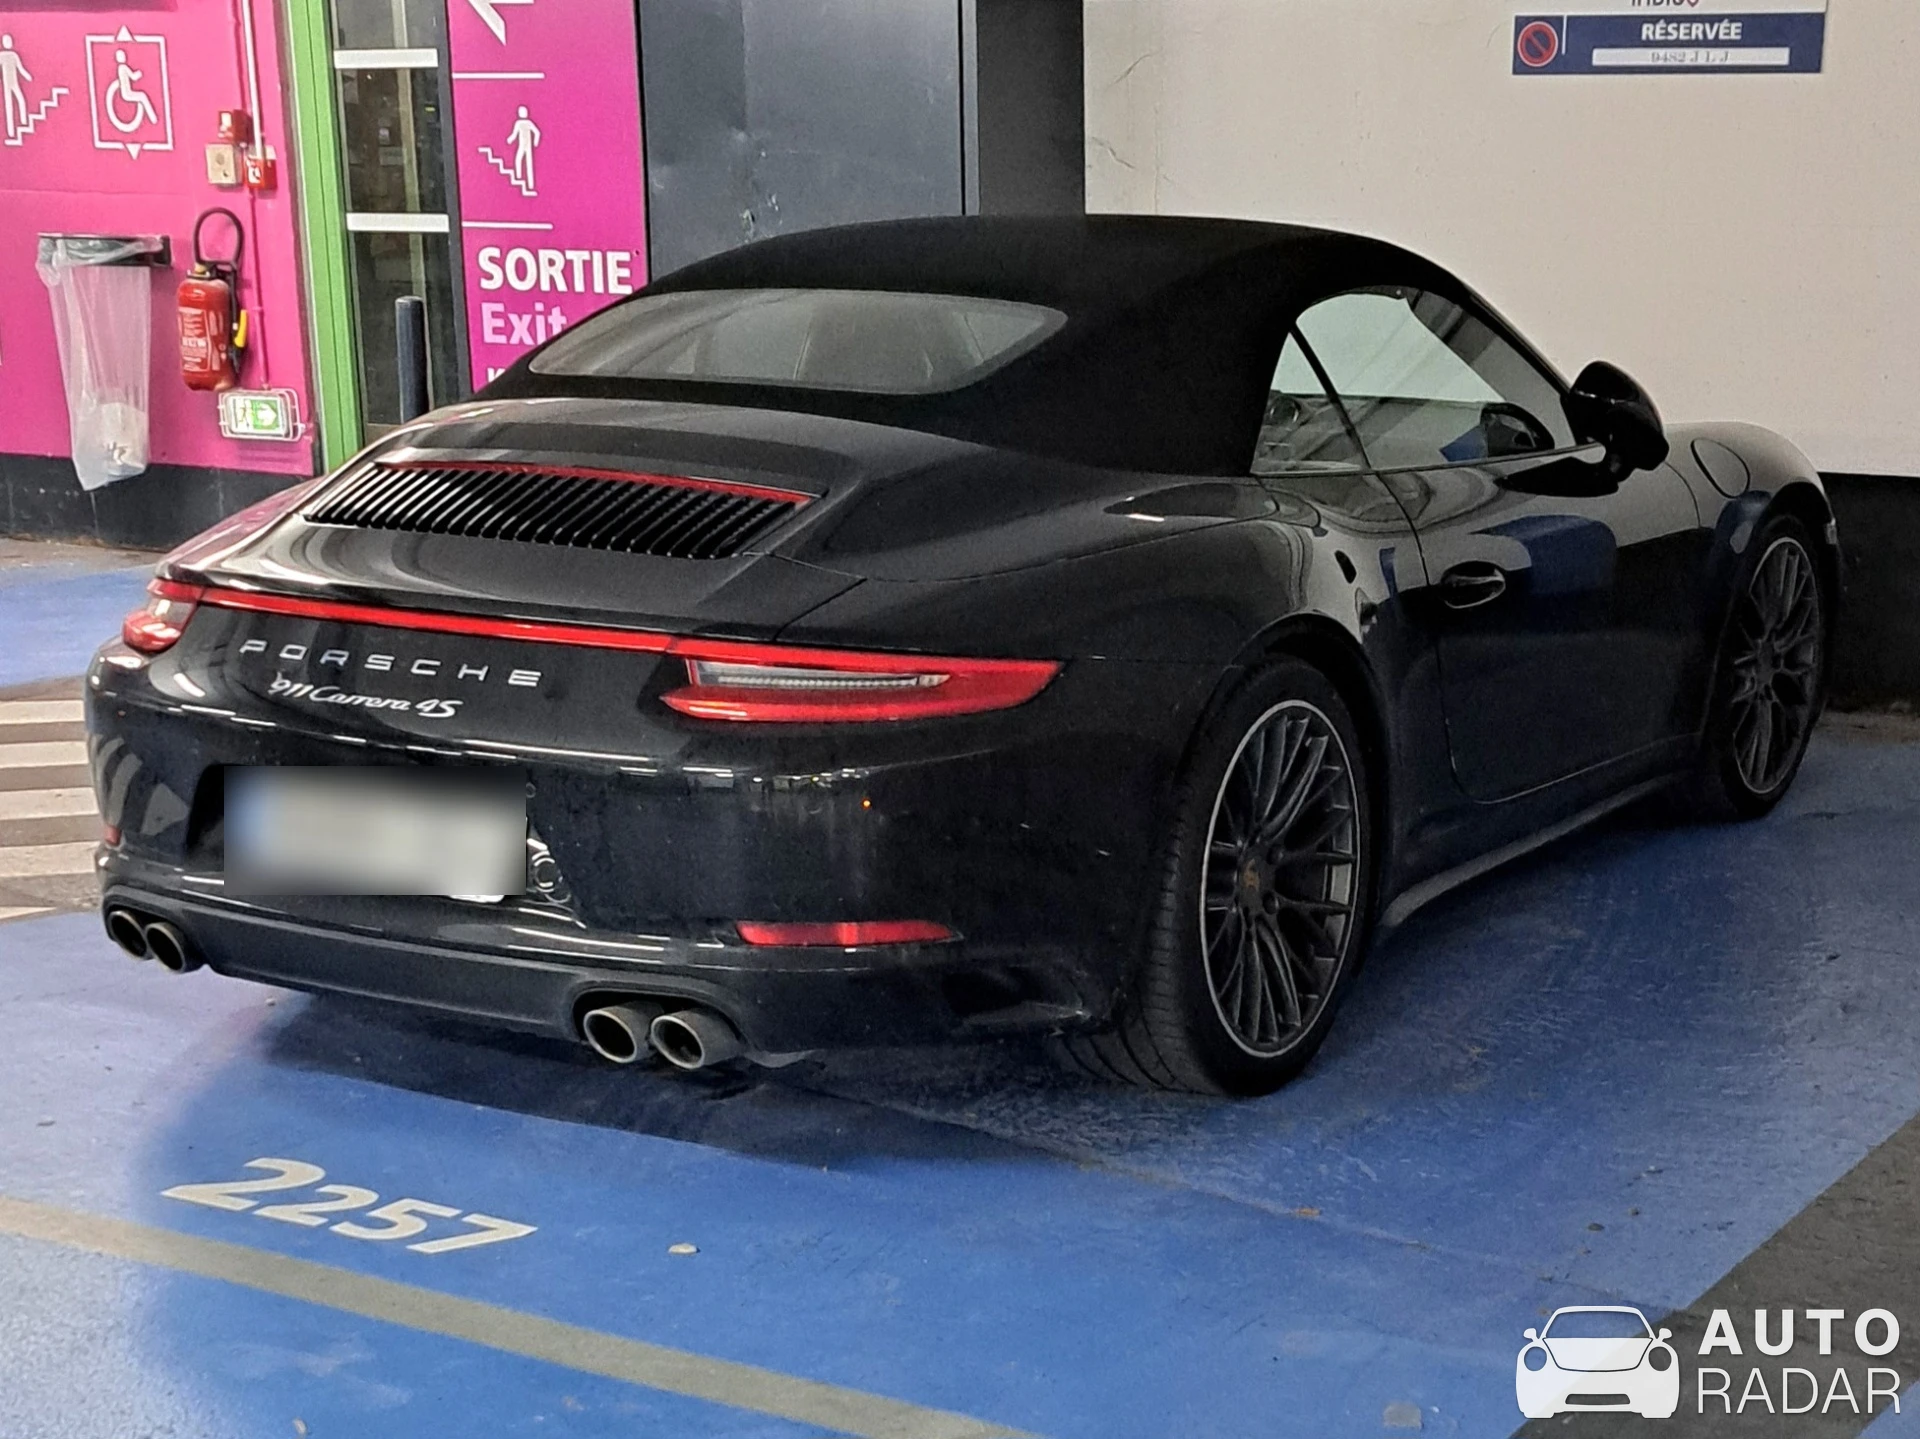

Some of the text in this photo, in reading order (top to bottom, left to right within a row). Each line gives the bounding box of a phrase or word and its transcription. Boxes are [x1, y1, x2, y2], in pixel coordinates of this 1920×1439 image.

[1641, 18, 1742, 40] RÉSERVÉE
[478, 246, 633, 295] SORTIE
[481, 302, 567, 345] Exit
[240, 639, 542, 686] PORSCHE
[415, 699, 464, 718] 4S
[160, 1157, 538, 1255] 2257
